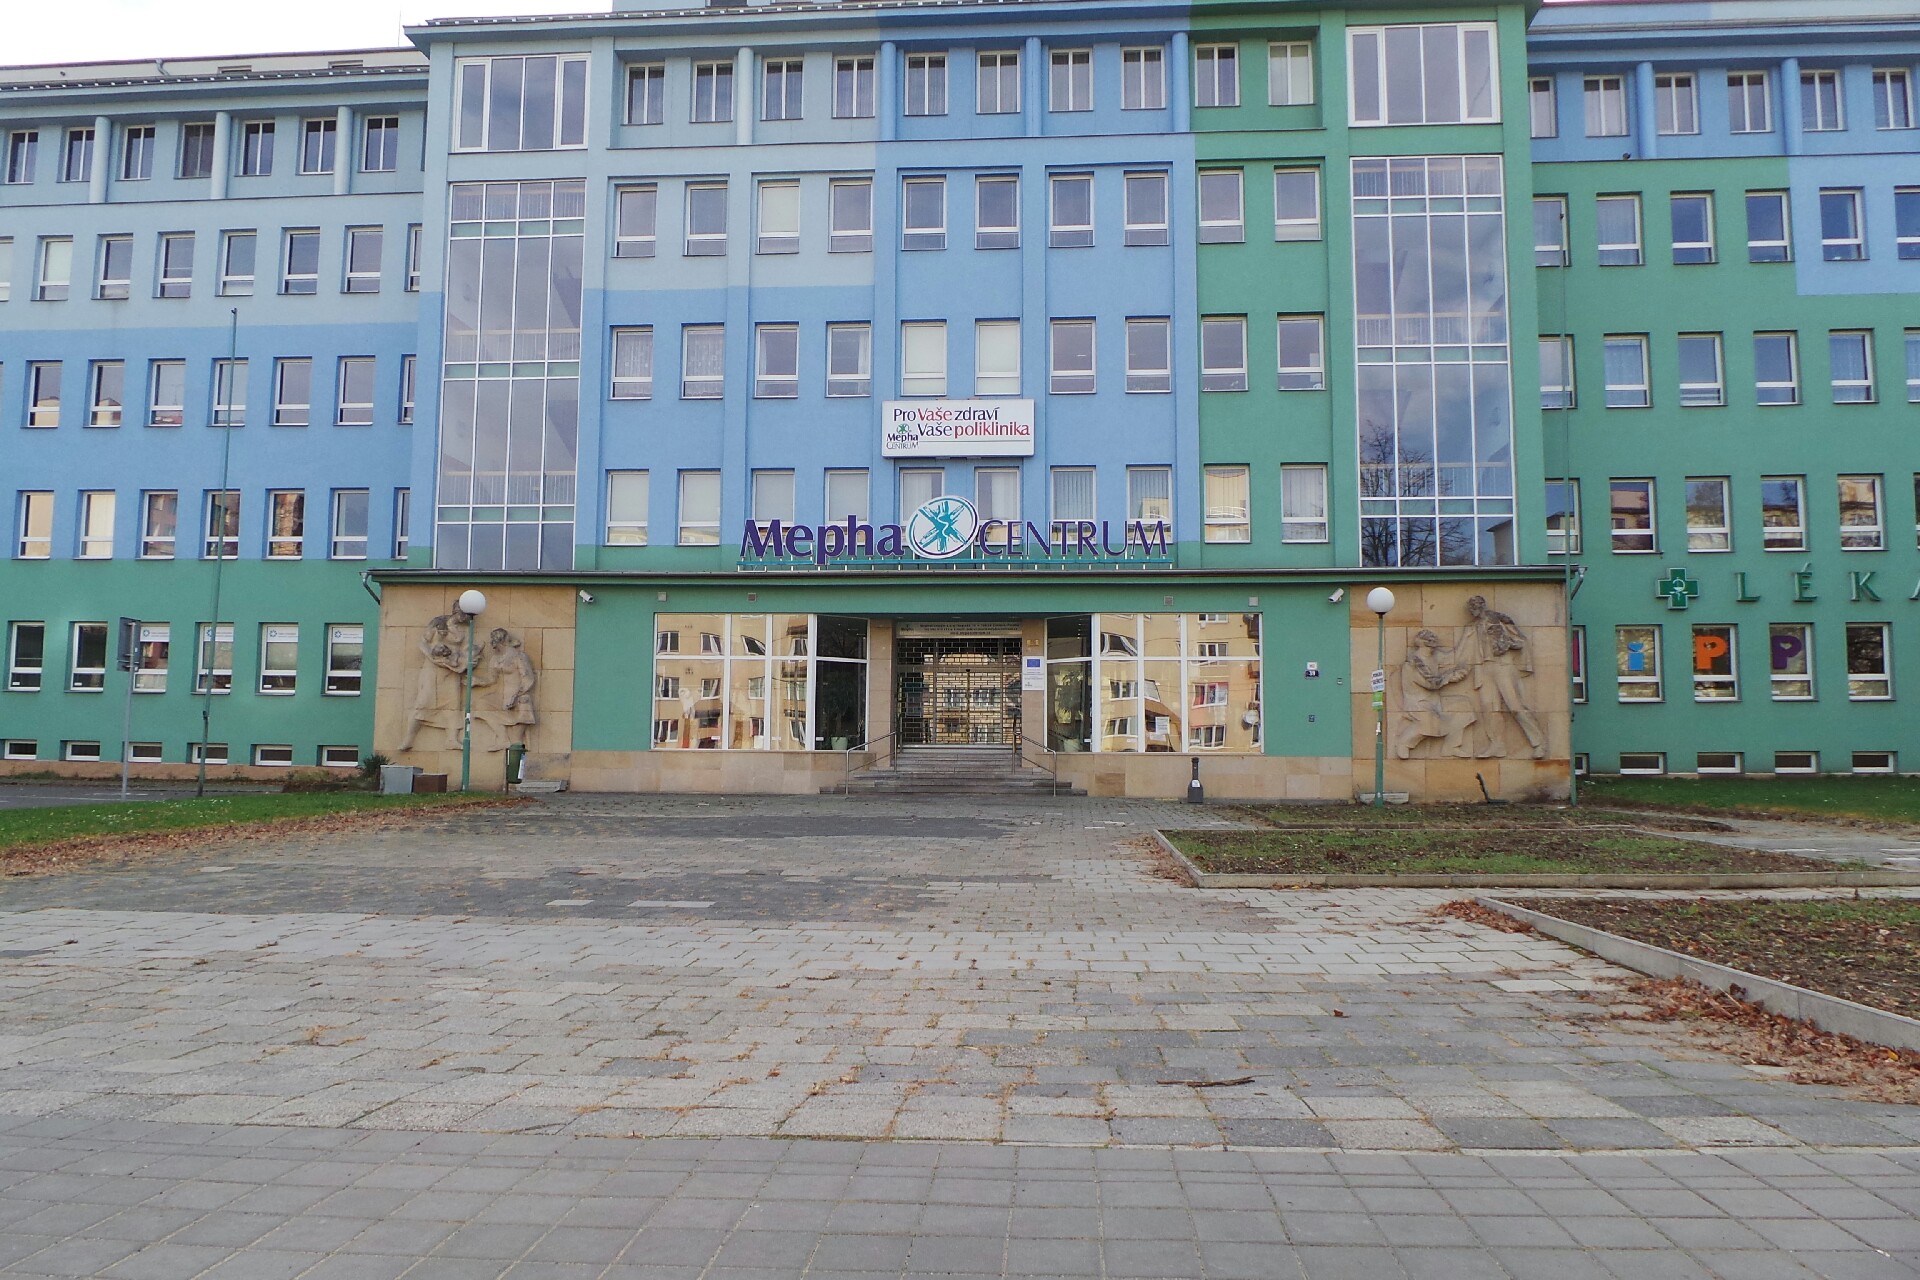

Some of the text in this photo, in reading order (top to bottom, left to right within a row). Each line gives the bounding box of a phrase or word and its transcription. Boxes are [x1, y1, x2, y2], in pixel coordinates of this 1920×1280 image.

[893, 406, 1000, 421] Pro Vaše zdraví
[886, 432, 919, 443] Mepha
[917, 421, 1030, 439] Vaše poliklinika
[740, 514, 1168, 565] Mepha CENTRUM
